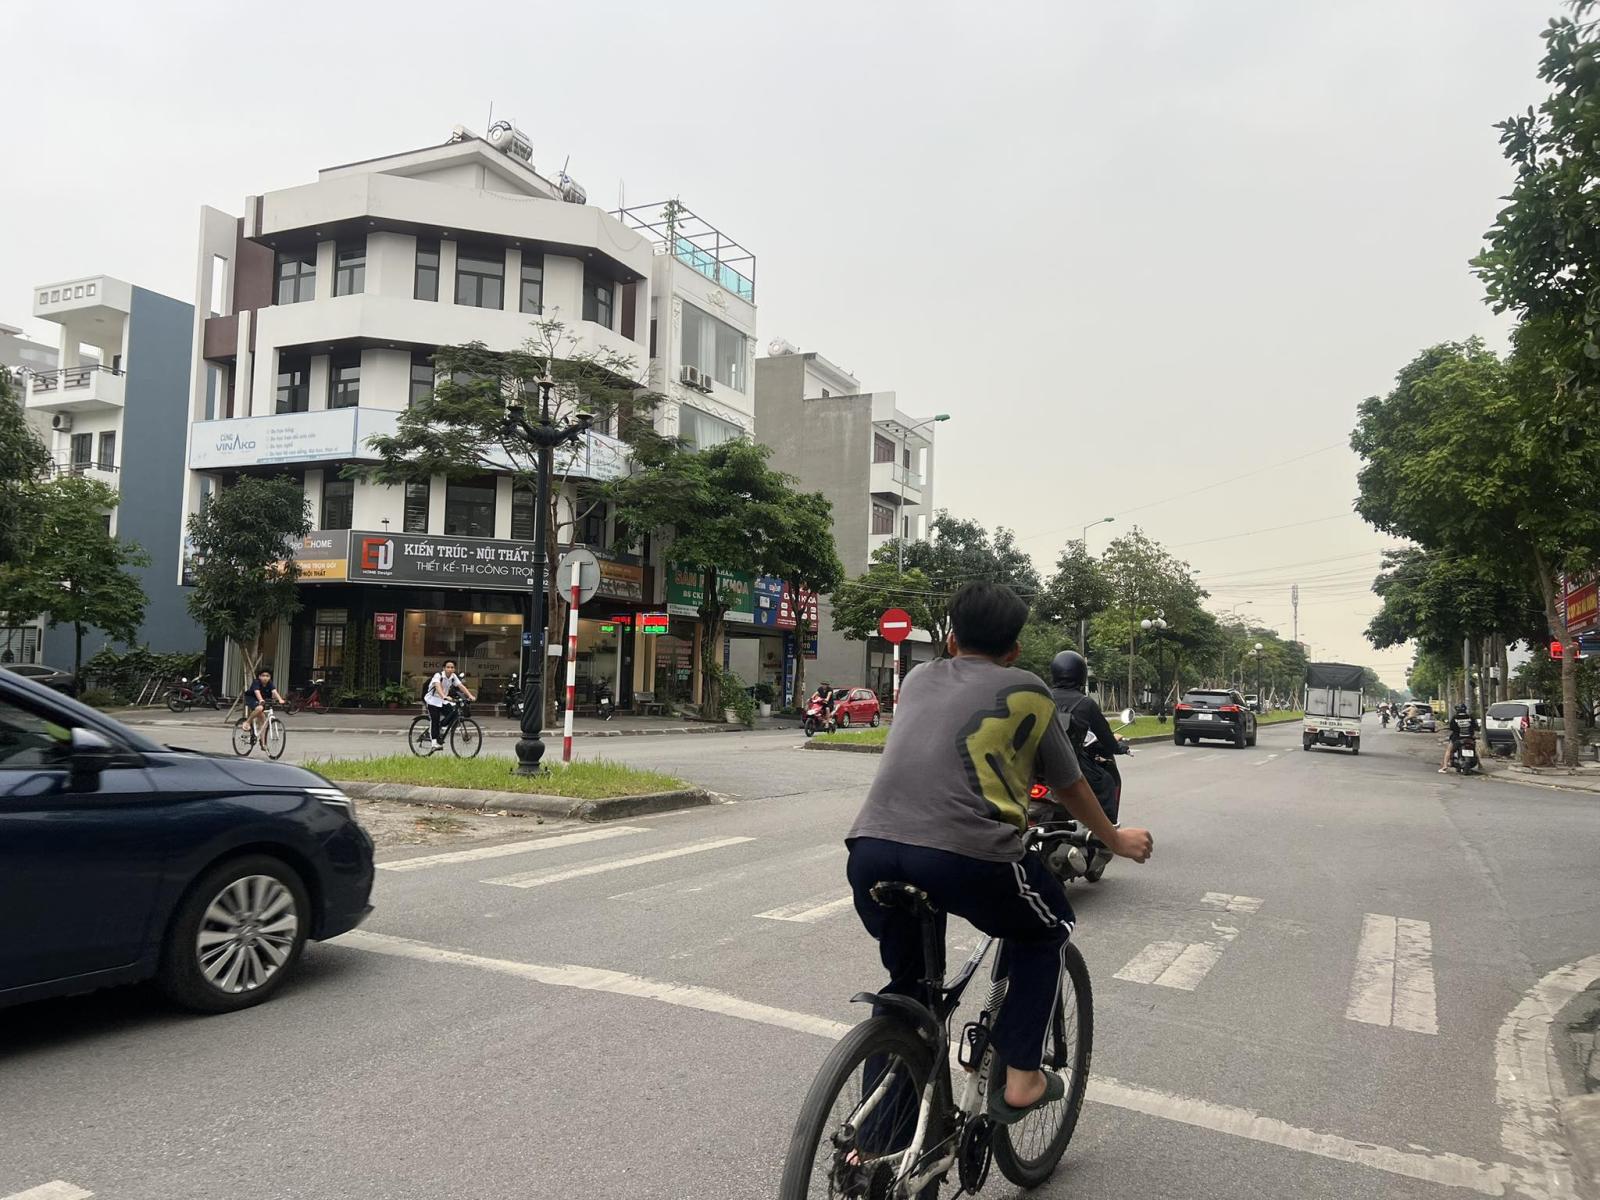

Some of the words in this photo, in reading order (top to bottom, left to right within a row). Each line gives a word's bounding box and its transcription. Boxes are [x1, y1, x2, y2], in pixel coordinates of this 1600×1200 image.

[404, 540, 434, 557] KIẾN
[437, 543, 468, 558] TRÚC
[476, 546, 496, 562] NỘI
[498, 545, 529, 562] THẤT
[416, 559, 440, 572] THIẾT
[476, 563, 509, 575] CÔNG
